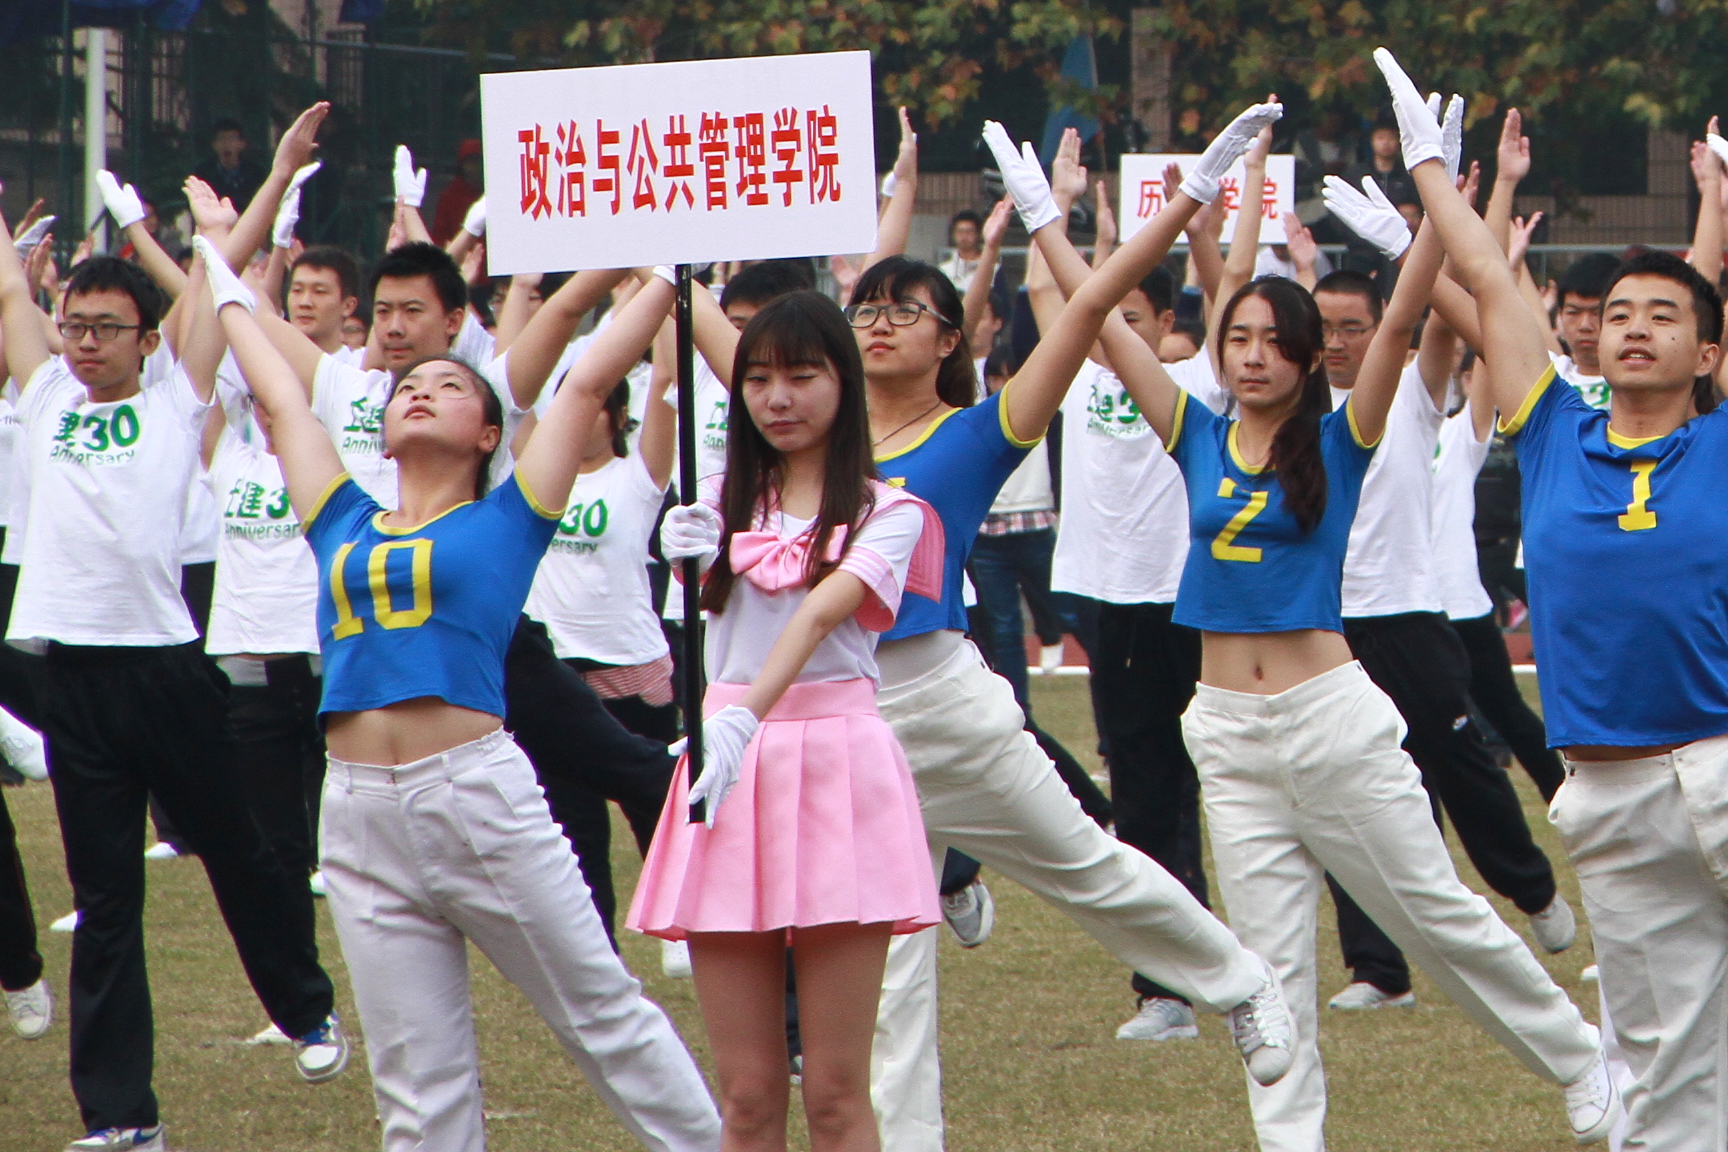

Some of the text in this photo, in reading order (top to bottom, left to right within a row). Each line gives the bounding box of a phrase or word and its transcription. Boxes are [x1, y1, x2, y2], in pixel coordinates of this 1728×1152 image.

[518, 104, 841, 222] 政治与公共管理学院
[559, 499, 608, 537] 30
[1211, 477, 1269, 563] 2
[329, 537, 434, 641] 10
